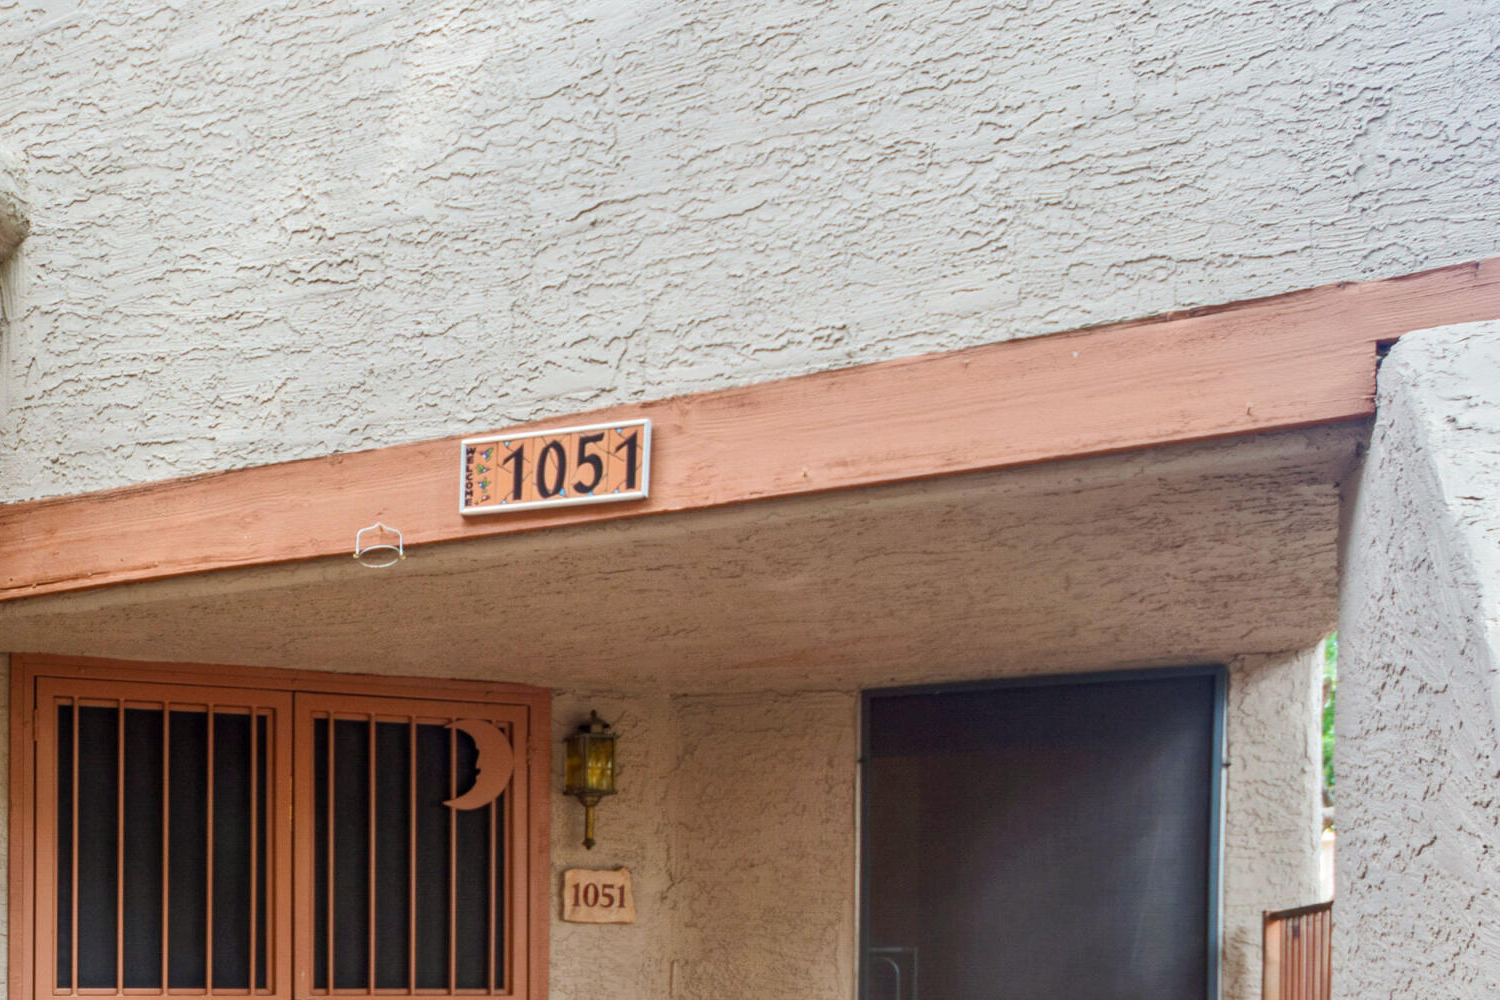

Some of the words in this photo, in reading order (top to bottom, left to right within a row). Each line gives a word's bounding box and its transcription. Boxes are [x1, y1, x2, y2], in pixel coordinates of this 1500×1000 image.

[465, 447, 476, 506] WELCOME
[502, 429, 638, 500] 1051
[572, 882, 625, 908] 1051
